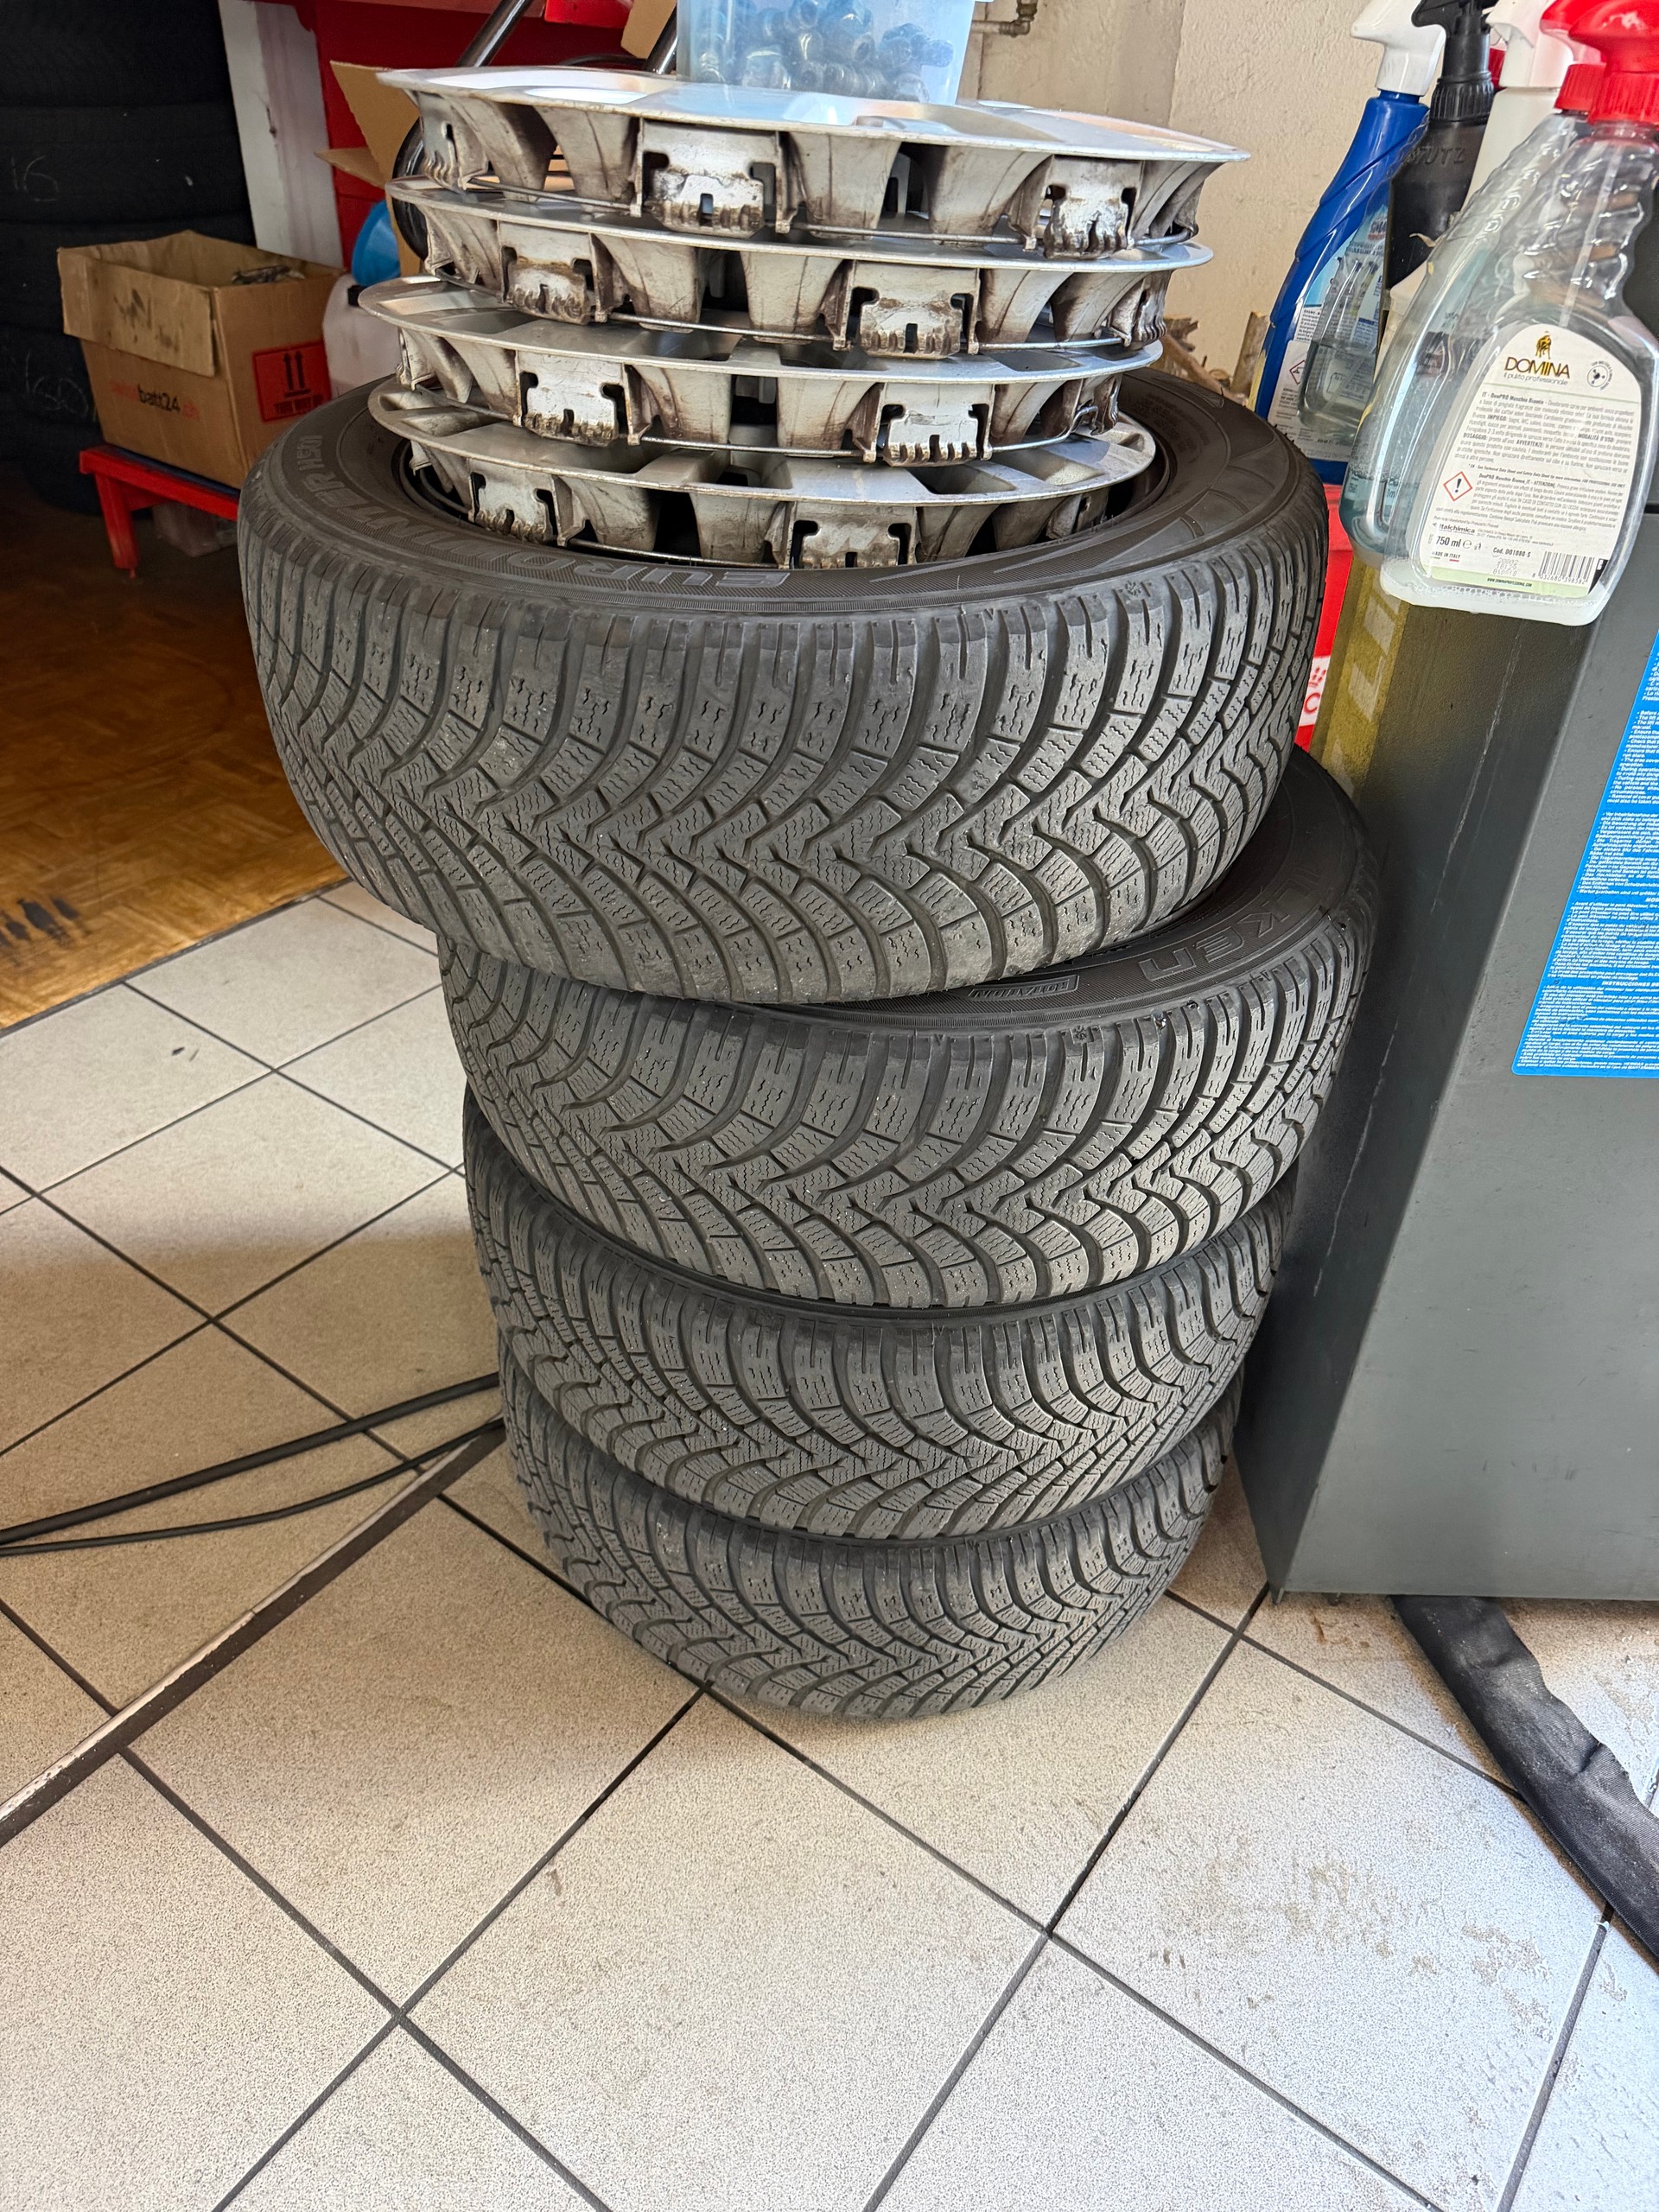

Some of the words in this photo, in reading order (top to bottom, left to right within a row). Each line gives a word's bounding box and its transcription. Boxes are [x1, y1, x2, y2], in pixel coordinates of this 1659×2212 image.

[1505, 356, 1570, 378] DOMINA
[1525, 374, 1568, 386] professionale
[1435, 536, 1450, 546] 750
[1450, 537, 1461, 547] ml
[973, 976, 1071, 999] ROTATION
